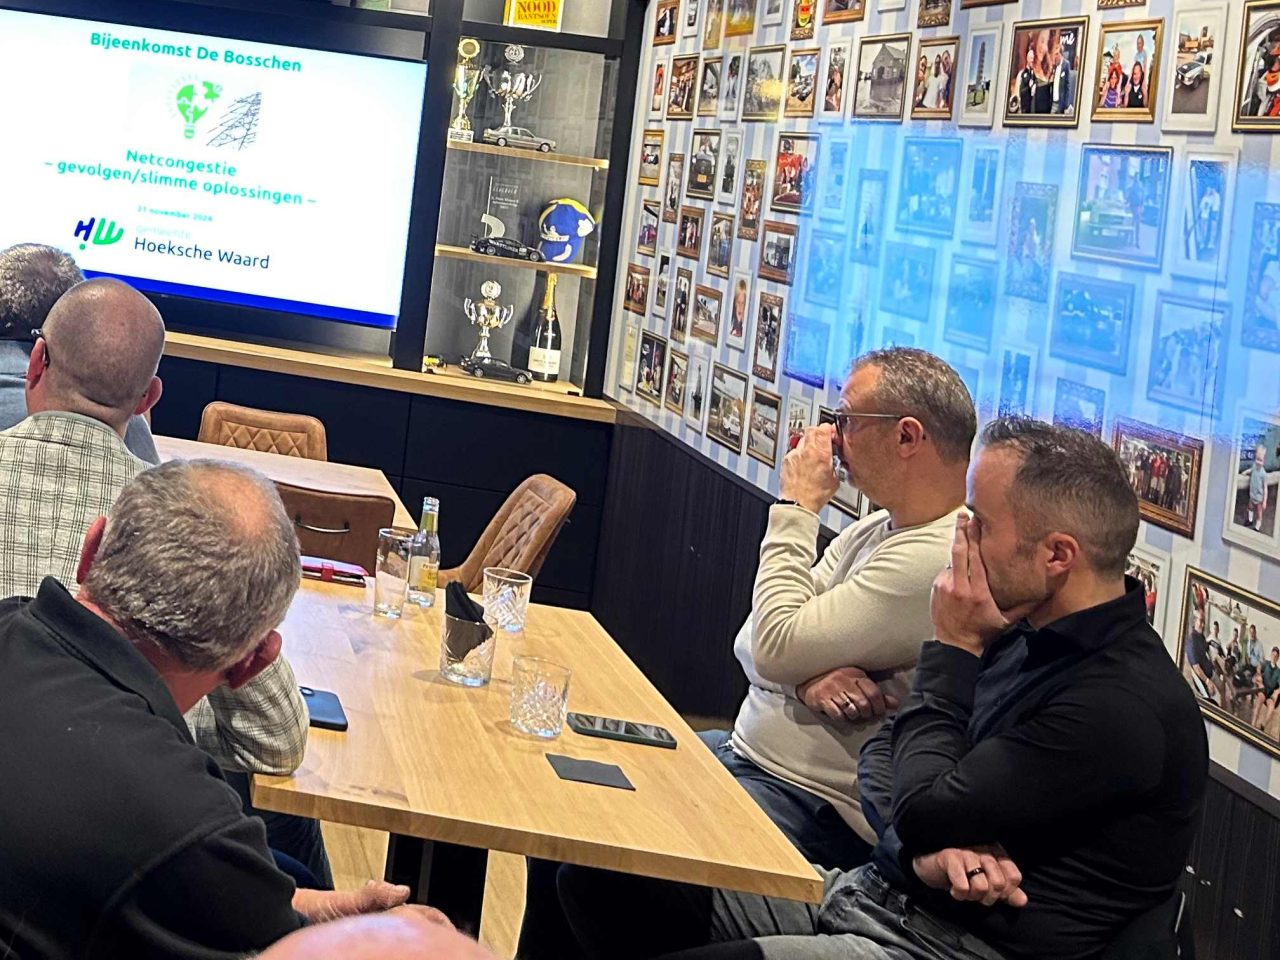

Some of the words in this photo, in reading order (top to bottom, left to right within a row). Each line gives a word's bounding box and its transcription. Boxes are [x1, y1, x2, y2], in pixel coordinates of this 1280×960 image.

[518, 0, 557, 13] NOOD
[91, 32, 192, 58] Bijeenkomst
[196, 46, 219, 61] De
[224, 50, 302, 72] Bosschen
[126, 150, 237, 177] Netcongestie
[57, 159, 198, 191] gevolgen/slimme
[203, 180, 303, 205] oplossingen
[149, 207, 191, 219] november
[134, 237, 213, 261] Hoeksche
[218, 249, 270, 269] Waard
